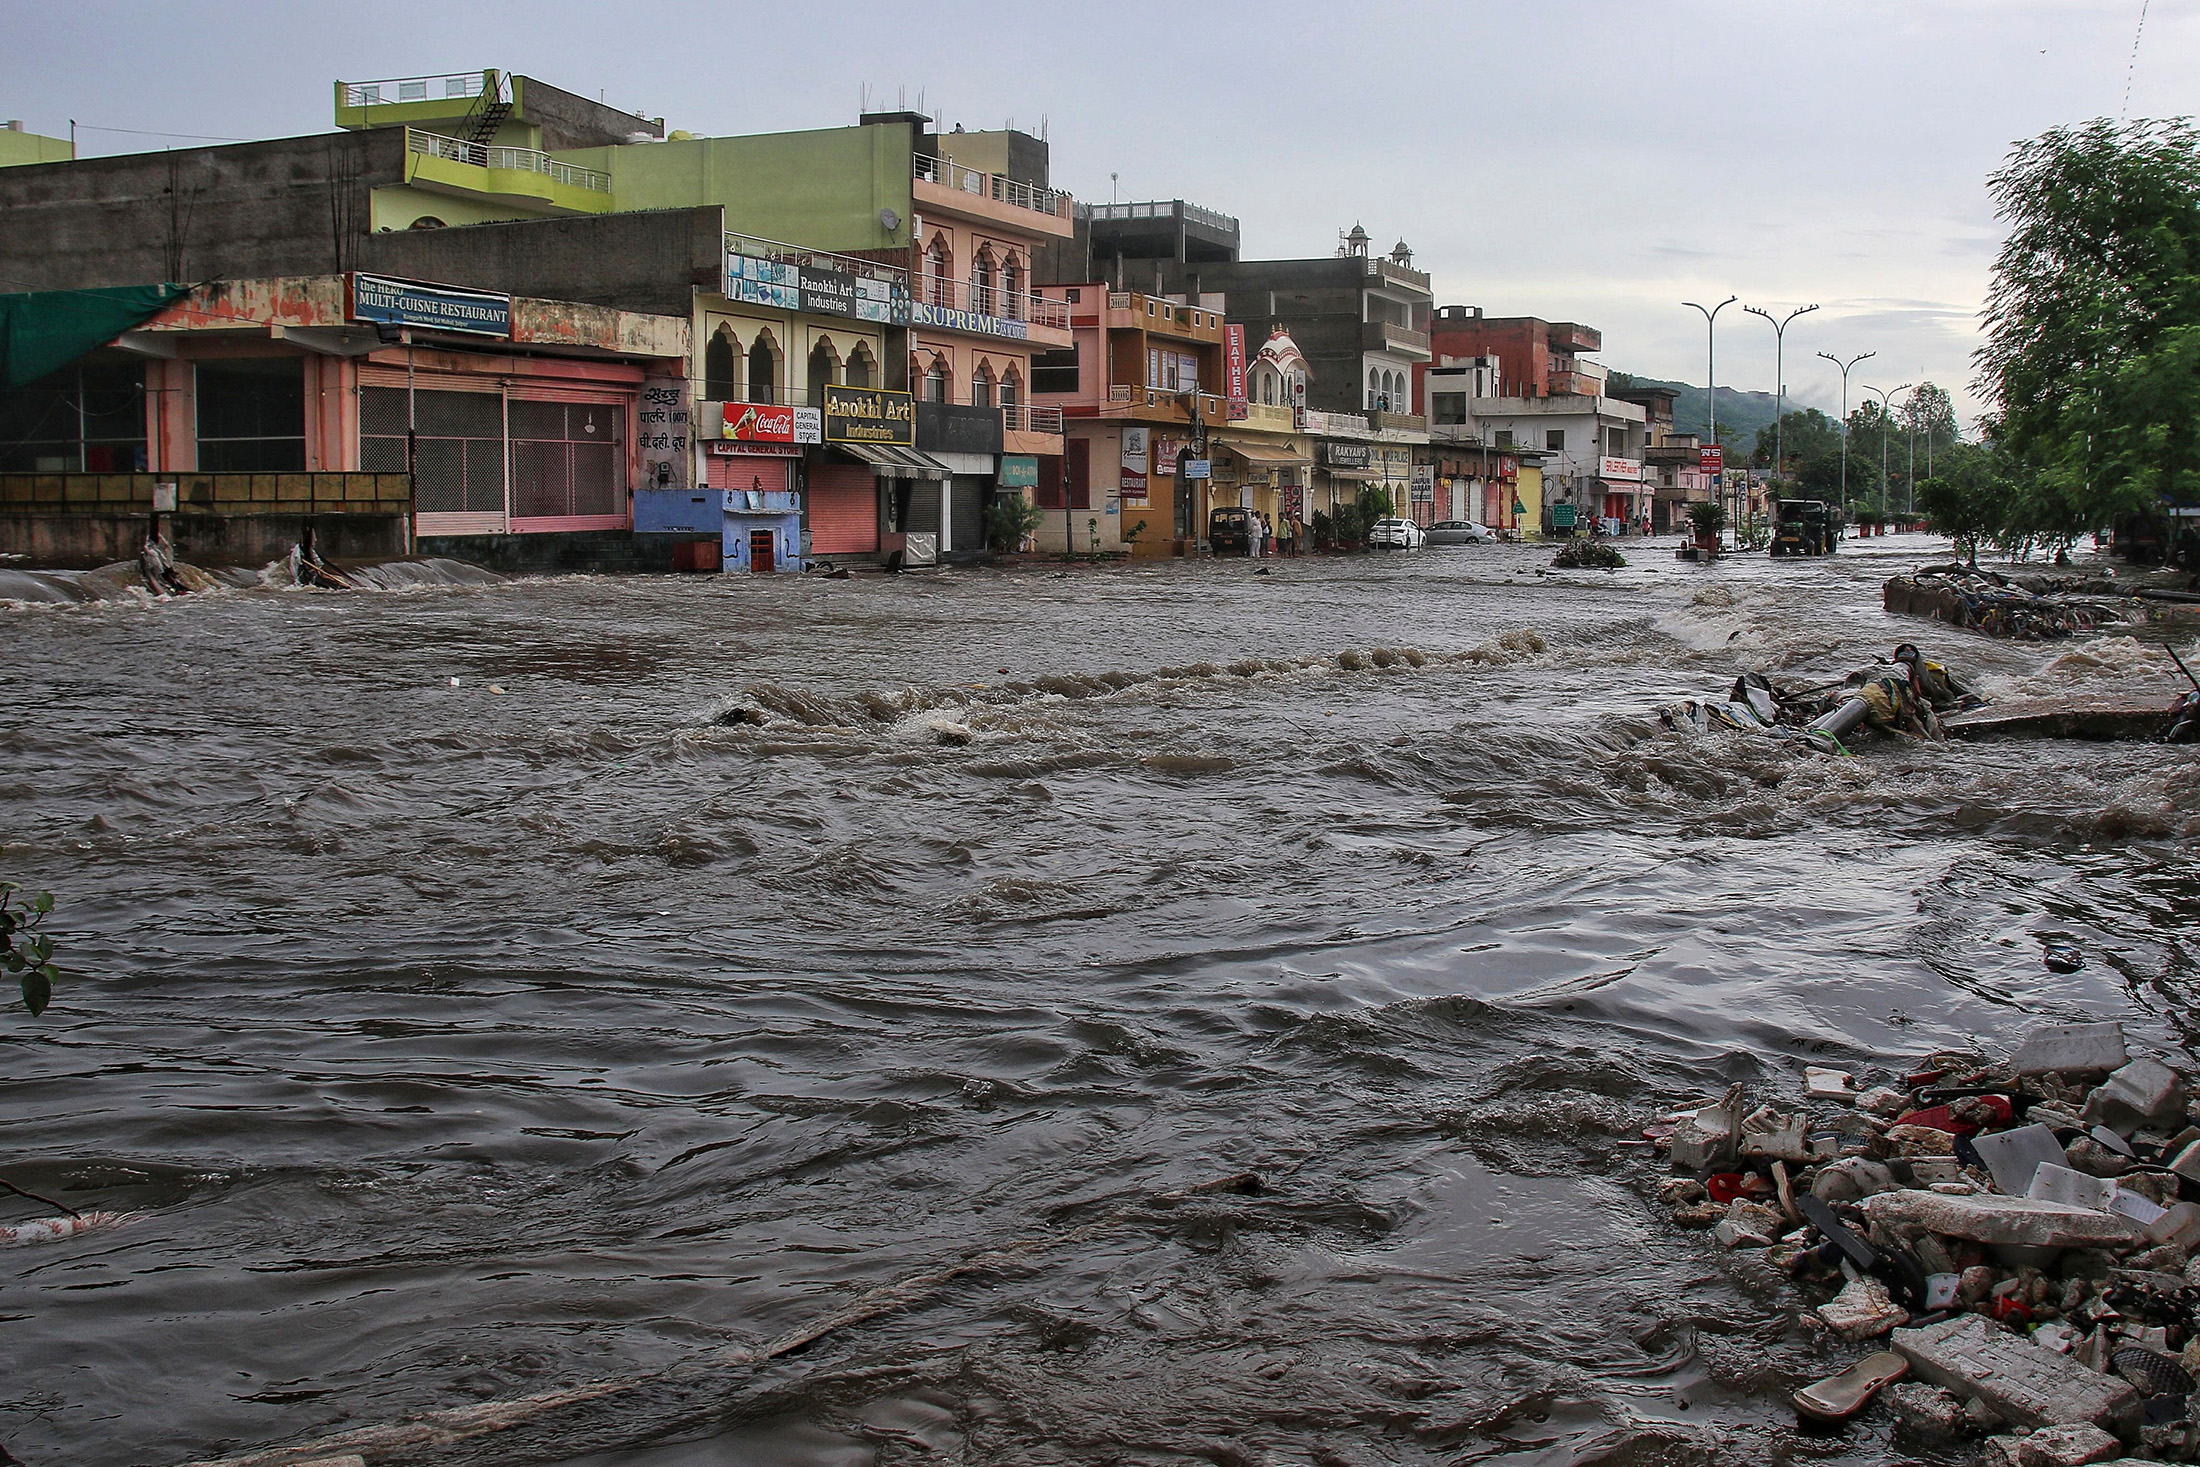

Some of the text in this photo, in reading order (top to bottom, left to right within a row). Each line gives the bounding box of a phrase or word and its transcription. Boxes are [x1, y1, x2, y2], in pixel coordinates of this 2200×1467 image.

[360, 280, 376, 292] the
[801, 276, 853, 297] Ranokhi Art
[807, 293, 847, 312] Industries
[440, 302, 508, 323] RESTAURANT
[923, 304, 1001, 336] SUPREME
[1230, 327, 1242, 396] LEATHER
[640, 407, 666, 423] पार्लर
[826, 393, 910, 421] Anokhi Art
[796, 411, 818, 421] CAPITAL
[795, 421, 820, 431] GENERAL
[846, 423, 894, 440] Industries
[798, 431, 817, 441] STORE
[717, 443, 799, 455] CAPITAL GENERAL STORE
[1121, 477, 1146, 489] RESTAURANT
[1411, 477, 1431, 485] JAIPUR
